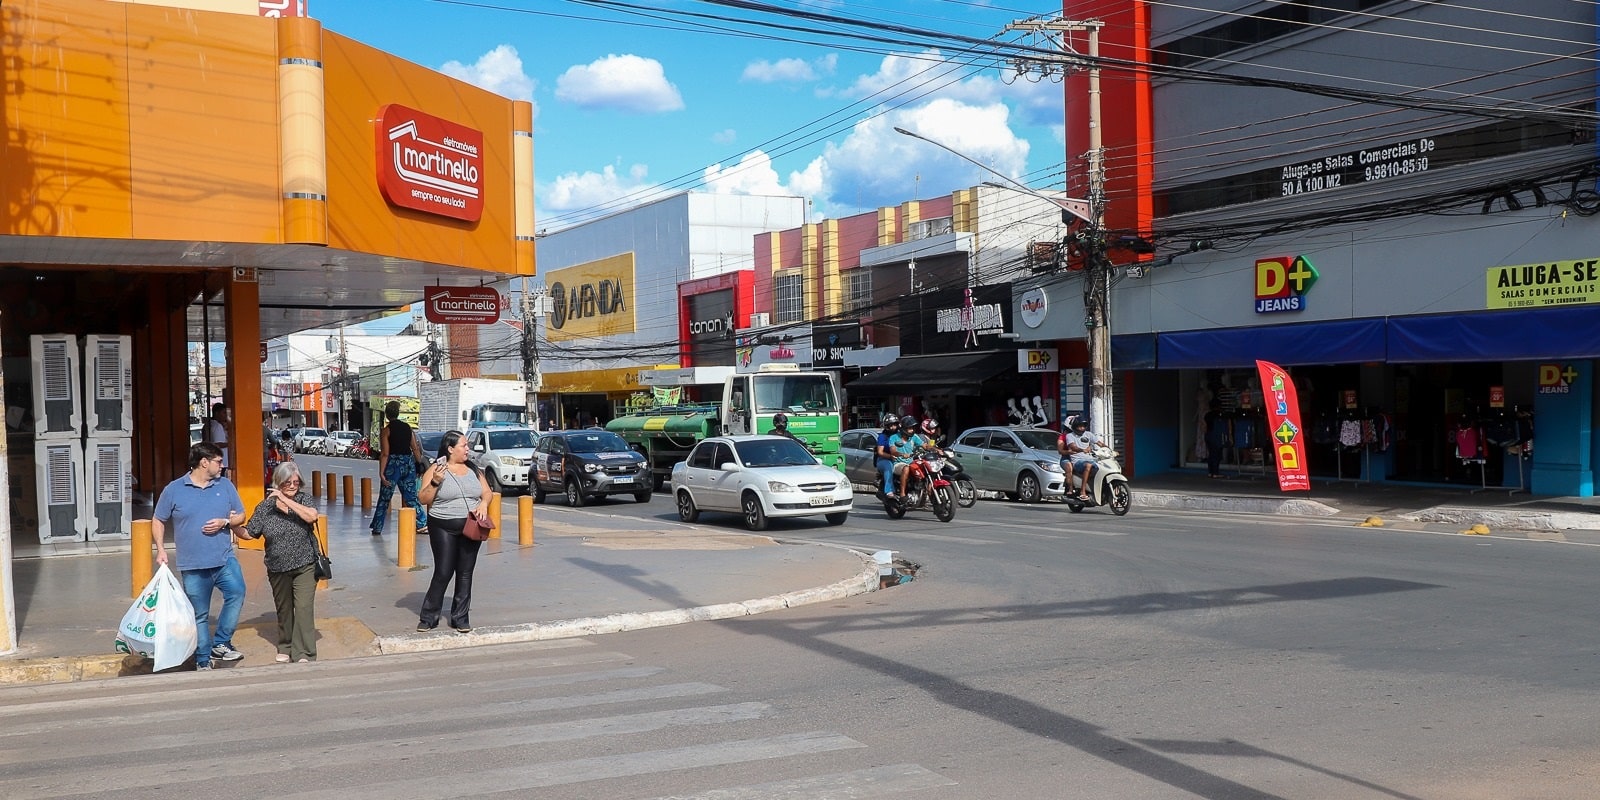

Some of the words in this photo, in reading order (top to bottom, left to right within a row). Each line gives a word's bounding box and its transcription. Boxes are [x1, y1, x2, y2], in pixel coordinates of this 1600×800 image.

[443, 136, 478, 154] eletromóveis
[404, 147, 478, 183] martinello
[1281, 162, 1323, 180] Aluga-se
[1325, 154, 1353, 171] Salas
[1359, 142, 1417, 165] Comerciais
[1420, 138, 1435, 153] De
[1282, 181, 1294, 196] 50
[1305, 176, 1323, 192] 100
[1326, 173, 1341, 188] M2
[411, 189, 433, 202] sempre
[434, 194, 442, 202] ao
[442, 196, 452, 205] seu
[452, 197, 466, 208] lado!
[1497, 259, 1599, 288] ALUGA-SE
[567, 277, 627, 320] AVENIDA
[1501, 289, 1525, 299] SALAS
[1529, 284, 1595, 297] COMERCIAIS
[441, 299, 496, 310] martinello
[1257, 297, 1299, 312] JEANS
[689, 319, 722, 335] tonon
[813, 348, 827, 361] TOP
[830, 346, 853, 360] SHO
[1540, 386, 1569, 394] JEANS
